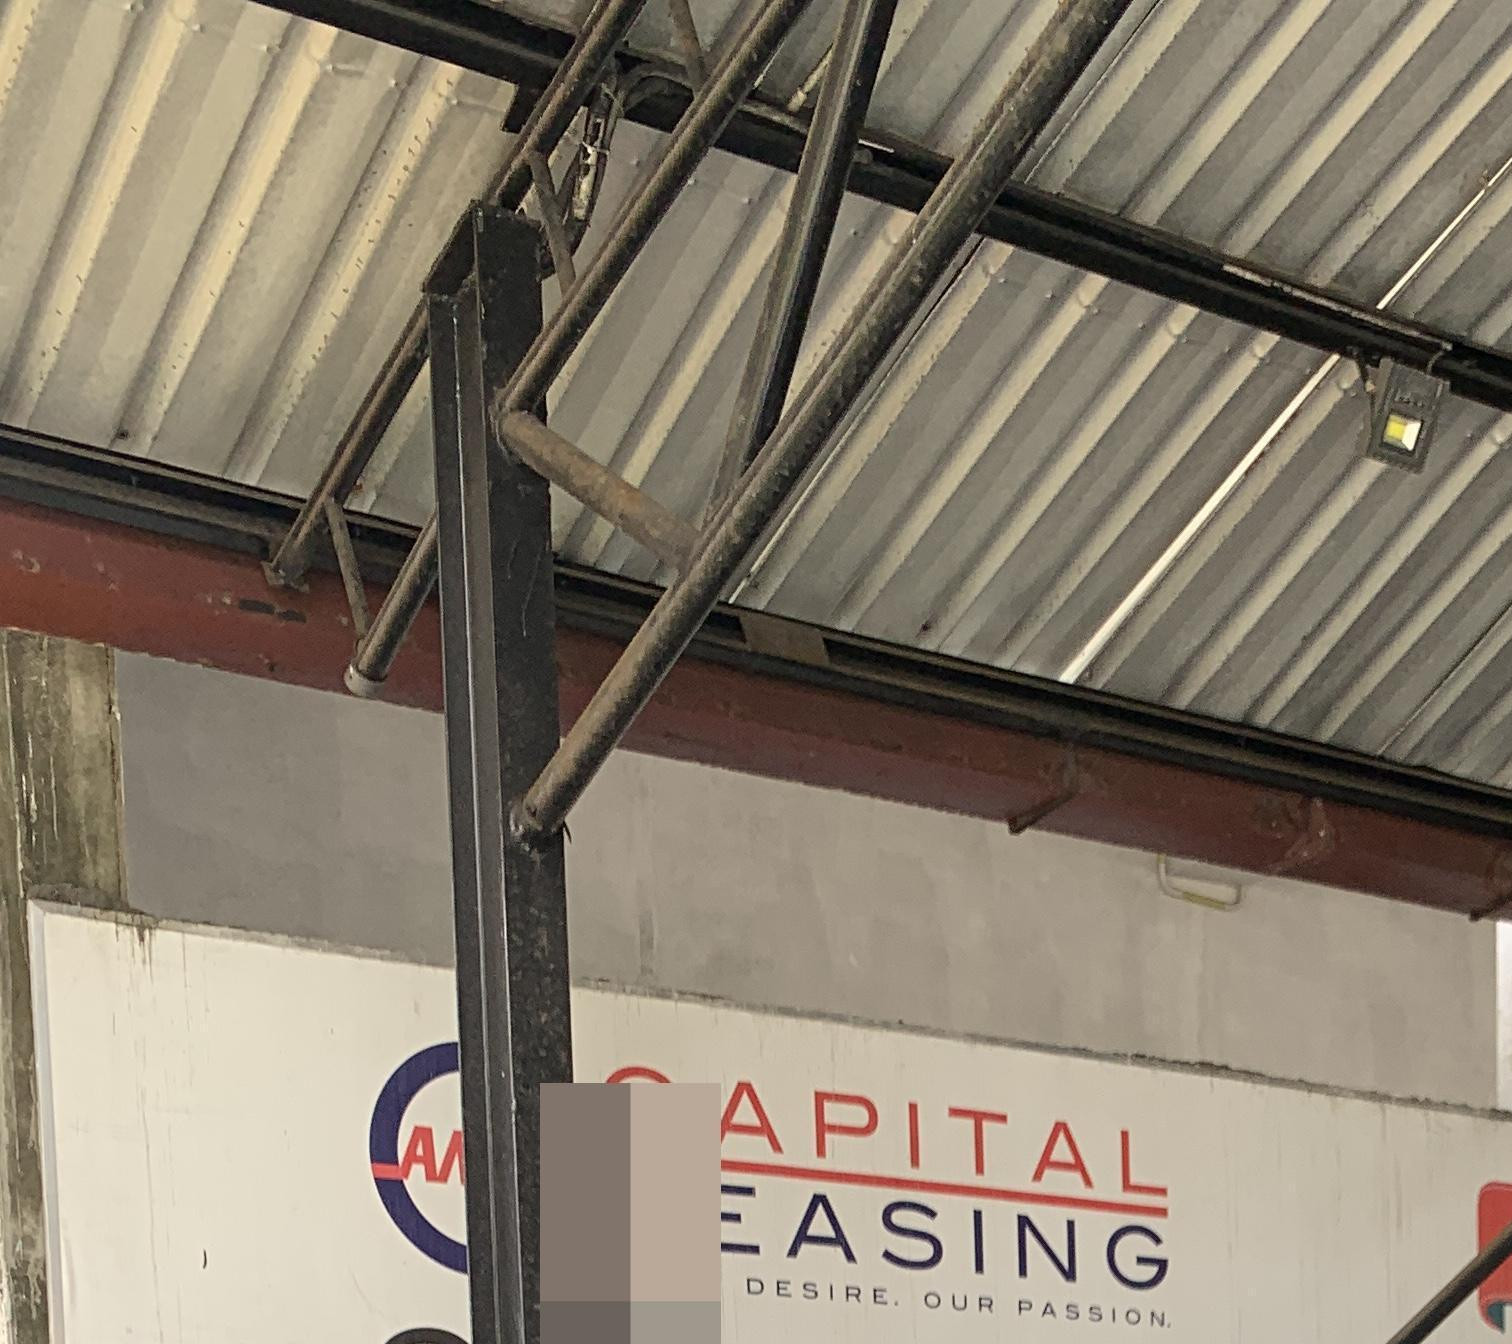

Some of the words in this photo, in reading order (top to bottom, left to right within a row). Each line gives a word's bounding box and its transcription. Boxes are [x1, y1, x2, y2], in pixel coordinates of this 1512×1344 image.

[605, 1066, 1169, 1197] APITAL
[721, 1184, 1169, 1290] EASING
[746, 1277, 899, 1307] DESIRE.
[924, 1292, 995, 1314] OUR
[1017, 1301, 1172, 1329] PASSION.
